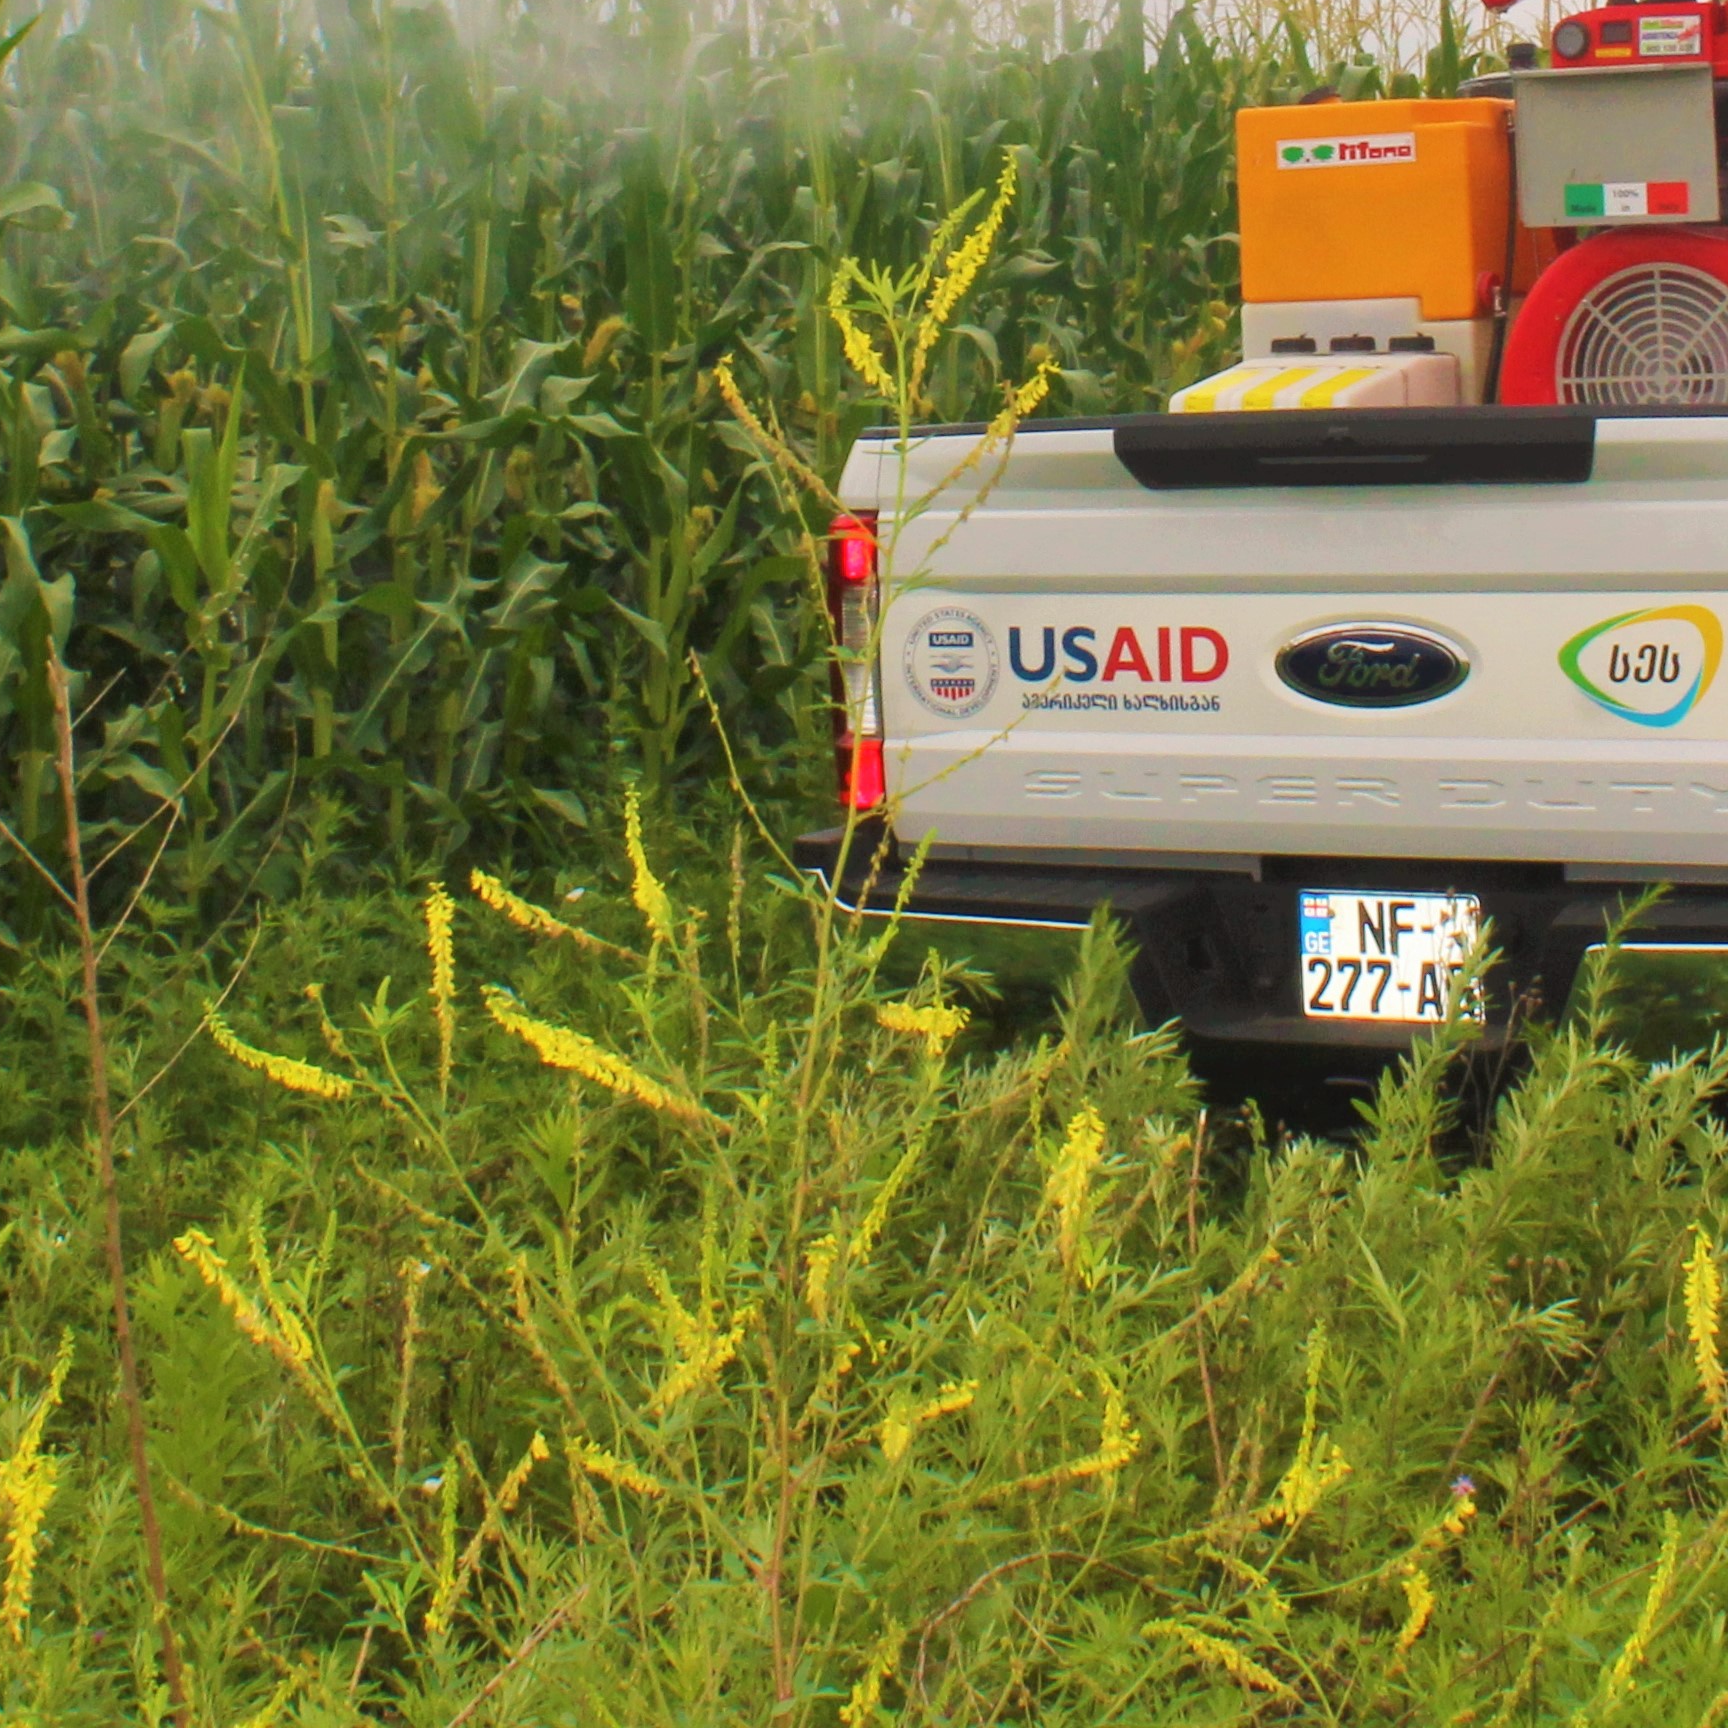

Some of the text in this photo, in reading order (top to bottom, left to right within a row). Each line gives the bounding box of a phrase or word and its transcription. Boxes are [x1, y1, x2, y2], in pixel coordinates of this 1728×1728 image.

[932, 633, 970, 646] USAID
[1009, 626, 1230, 683] USAID
[1318, 640, 1421, 688] Ford
[1609, 643, 1681, 683] სეს
[1024, 770, 1402, 807] SUPER
[1304, 930, 1331, 954] GE
